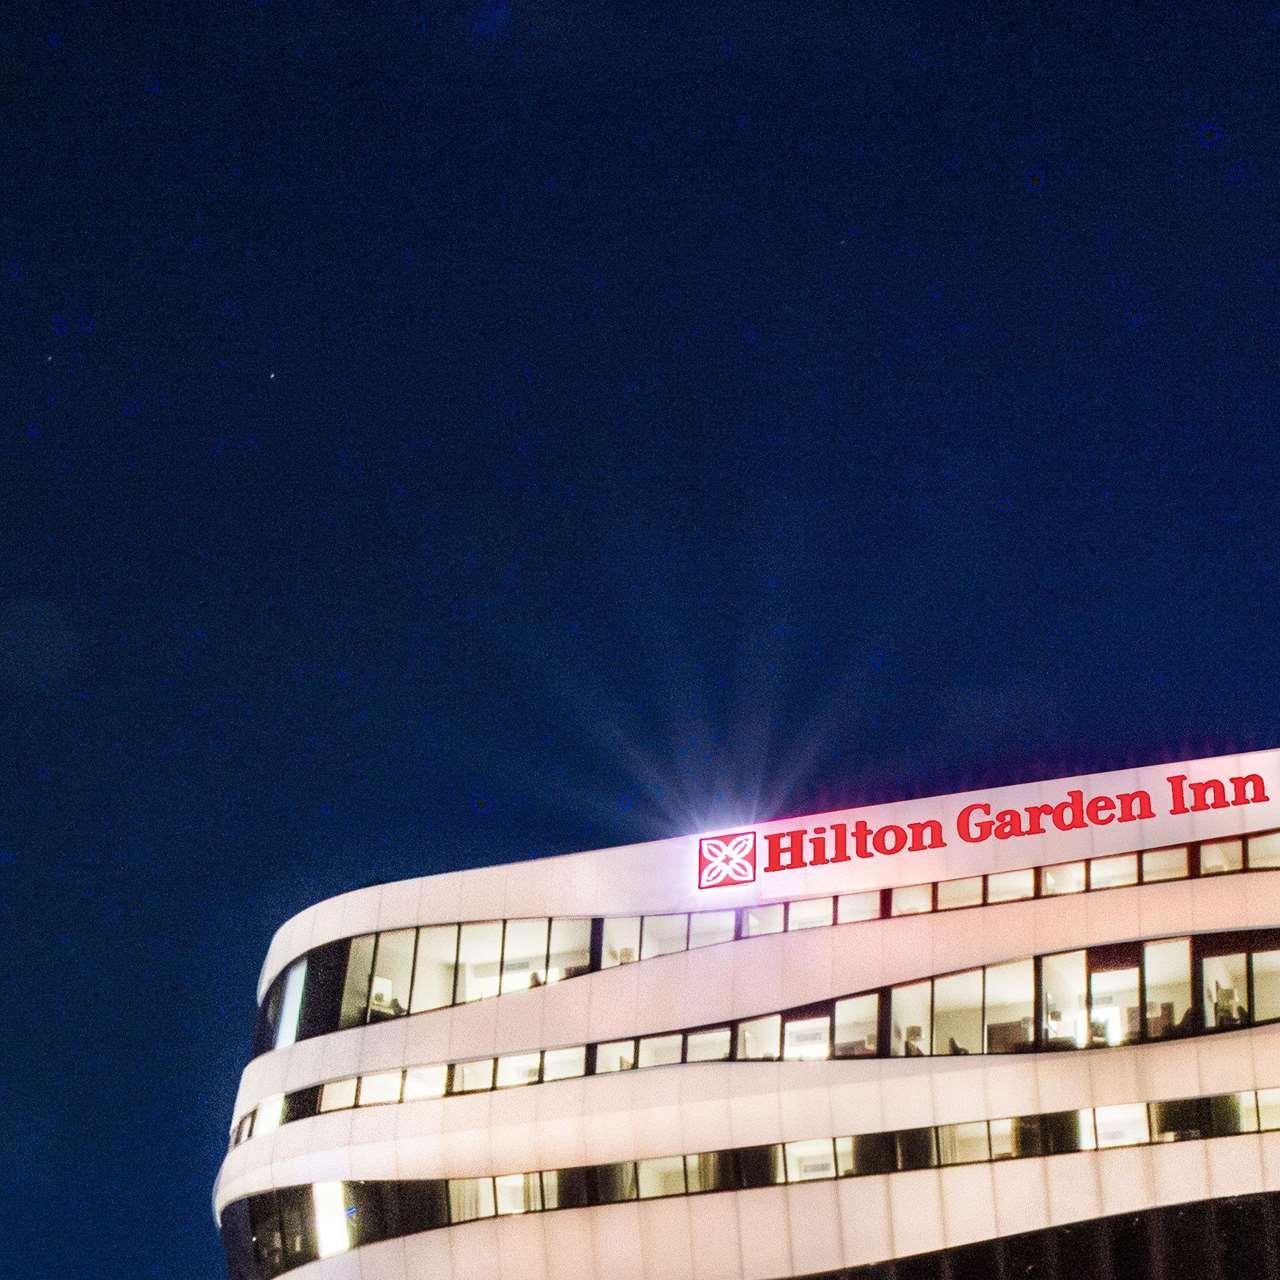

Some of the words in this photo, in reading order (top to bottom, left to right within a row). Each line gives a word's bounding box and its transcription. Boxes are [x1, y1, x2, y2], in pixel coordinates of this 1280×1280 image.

[763, 819, 947, 873] Hilton
[956, 789, 1156, 844] Garden
[1166, 773, 1270, 815] Inn
